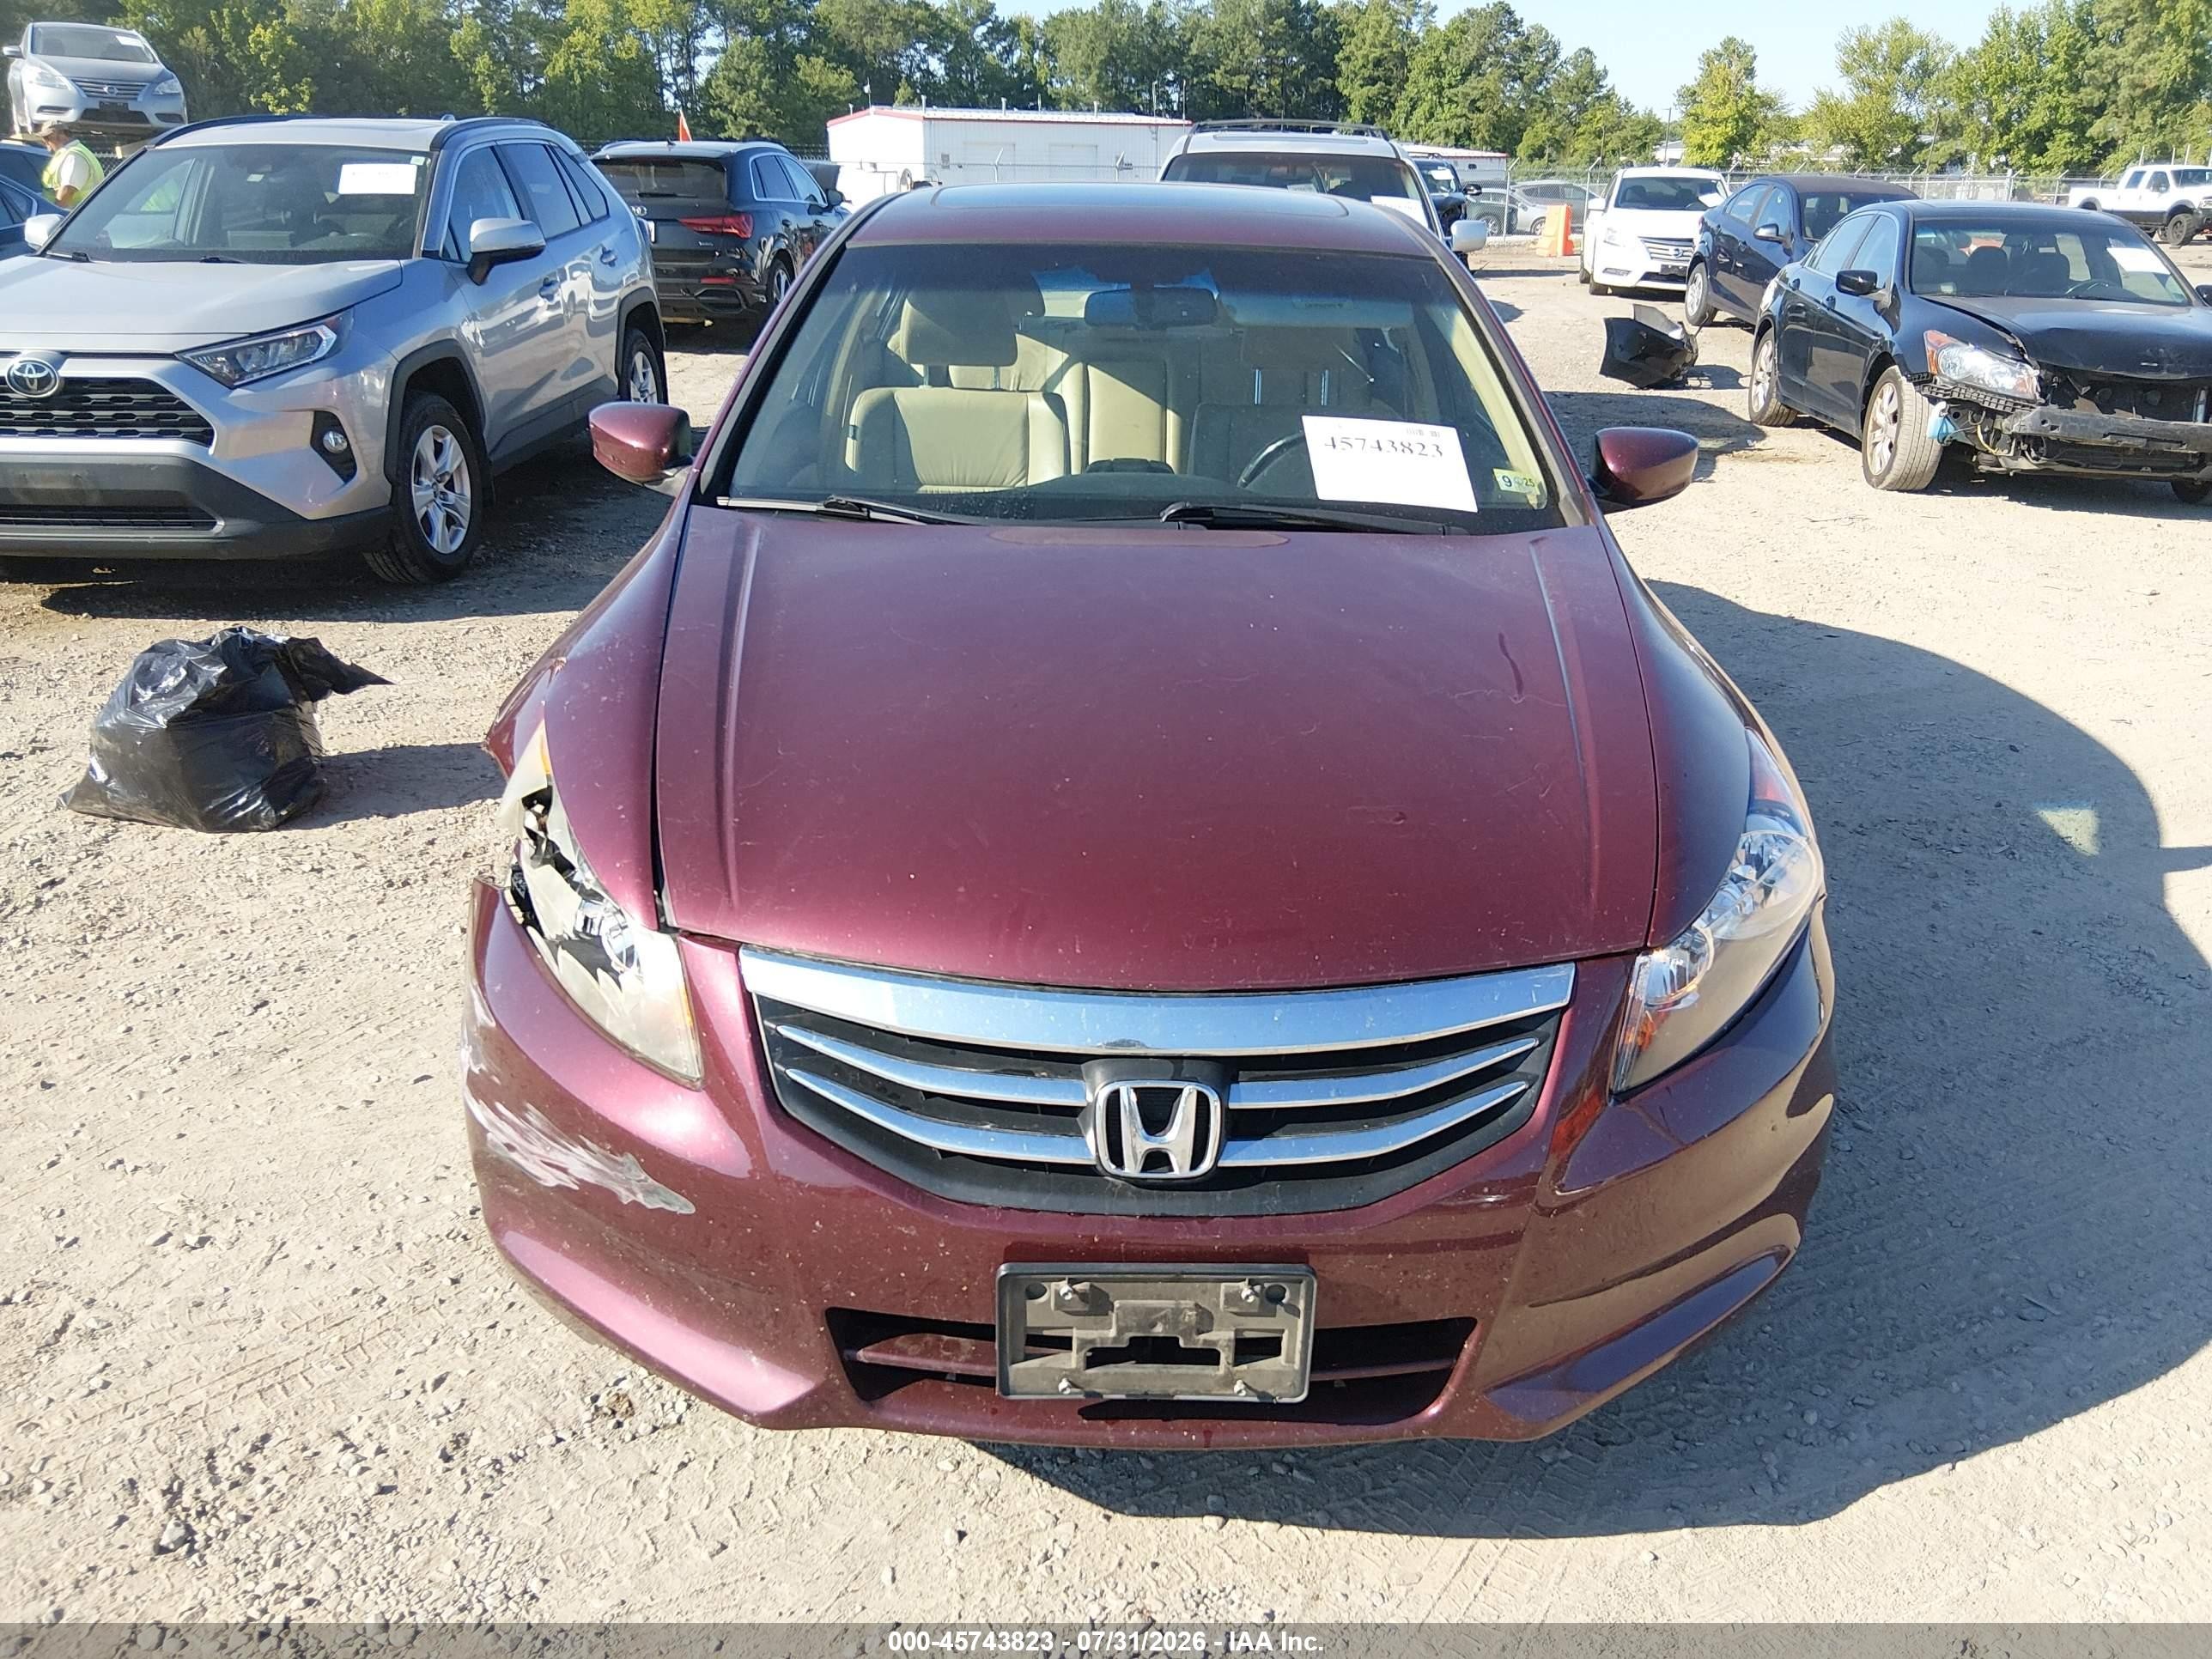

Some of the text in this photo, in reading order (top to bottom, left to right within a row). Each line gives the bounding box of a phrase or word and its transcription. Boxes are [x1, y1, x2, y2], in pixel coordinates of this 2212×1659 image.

[1325, 436, 1443, 457] 45743823
[1502, 475, 1535, 487] 9 25
